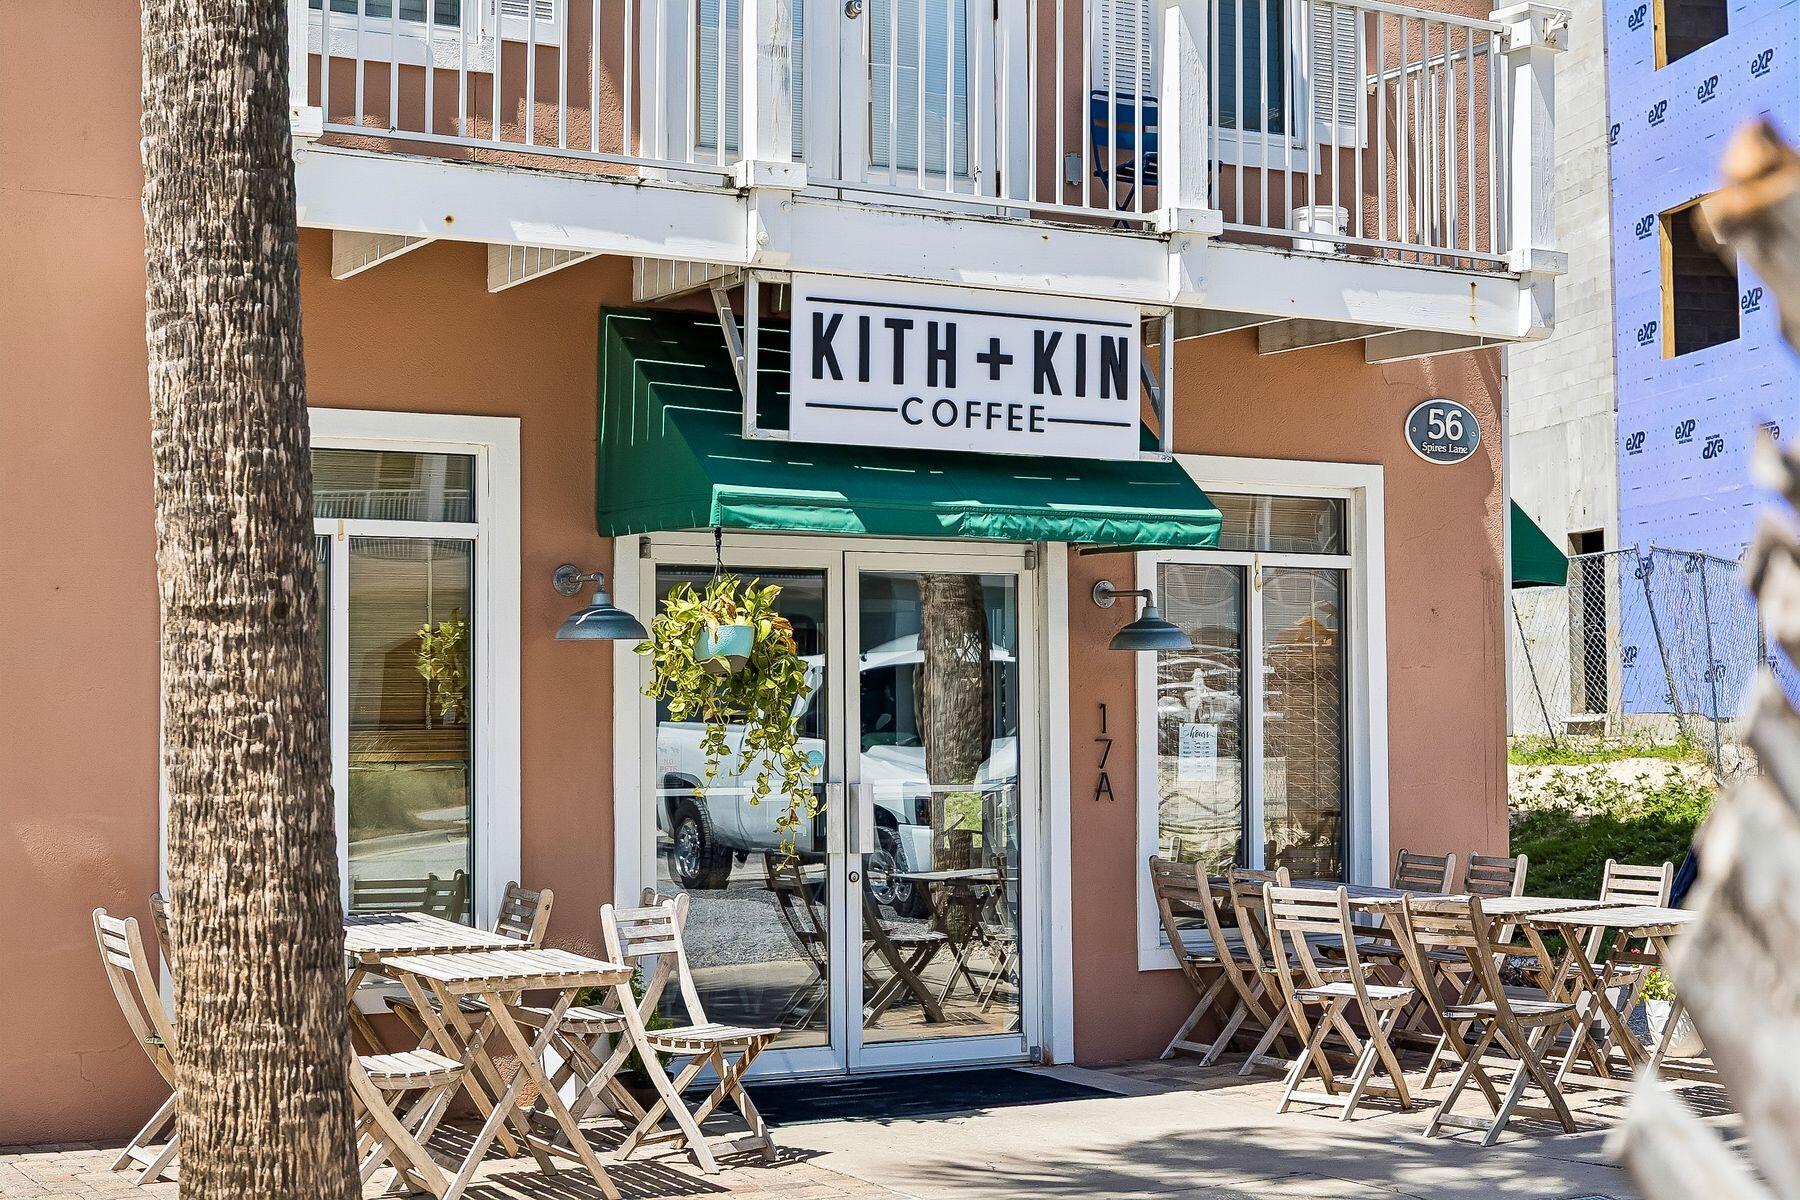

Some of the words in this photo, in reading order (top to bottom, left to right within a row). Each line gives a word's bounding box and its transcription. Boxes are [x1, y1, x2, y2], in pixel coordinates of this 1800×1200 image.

[1628, 4, 1647, 28] eXP
[1751, 48, 1774, 75] eXP
[1697, 75, 1719, 100] eXP
[1648, 99, 1667, 124] eXP
[1635, 213, 1655, 236] eXP
[1741, 287, 1763, 310] eXP
[1637, 321, 1657, 342] eXP
[812, 312, 957, 389] KITH
[977, 337, 1014, 381] +
[1033, 329, 1129, 401] KIN
[901, 396, 1045, 433] COFFEE
[1427, 408, 1464, 441] 56
[1626, 431, 1646, 451] eXP
[1675, 419, 1696, 440] eXP
[1421, 441, 1447, 453] Spires
[1448, 443, 1468, 454] Lane
